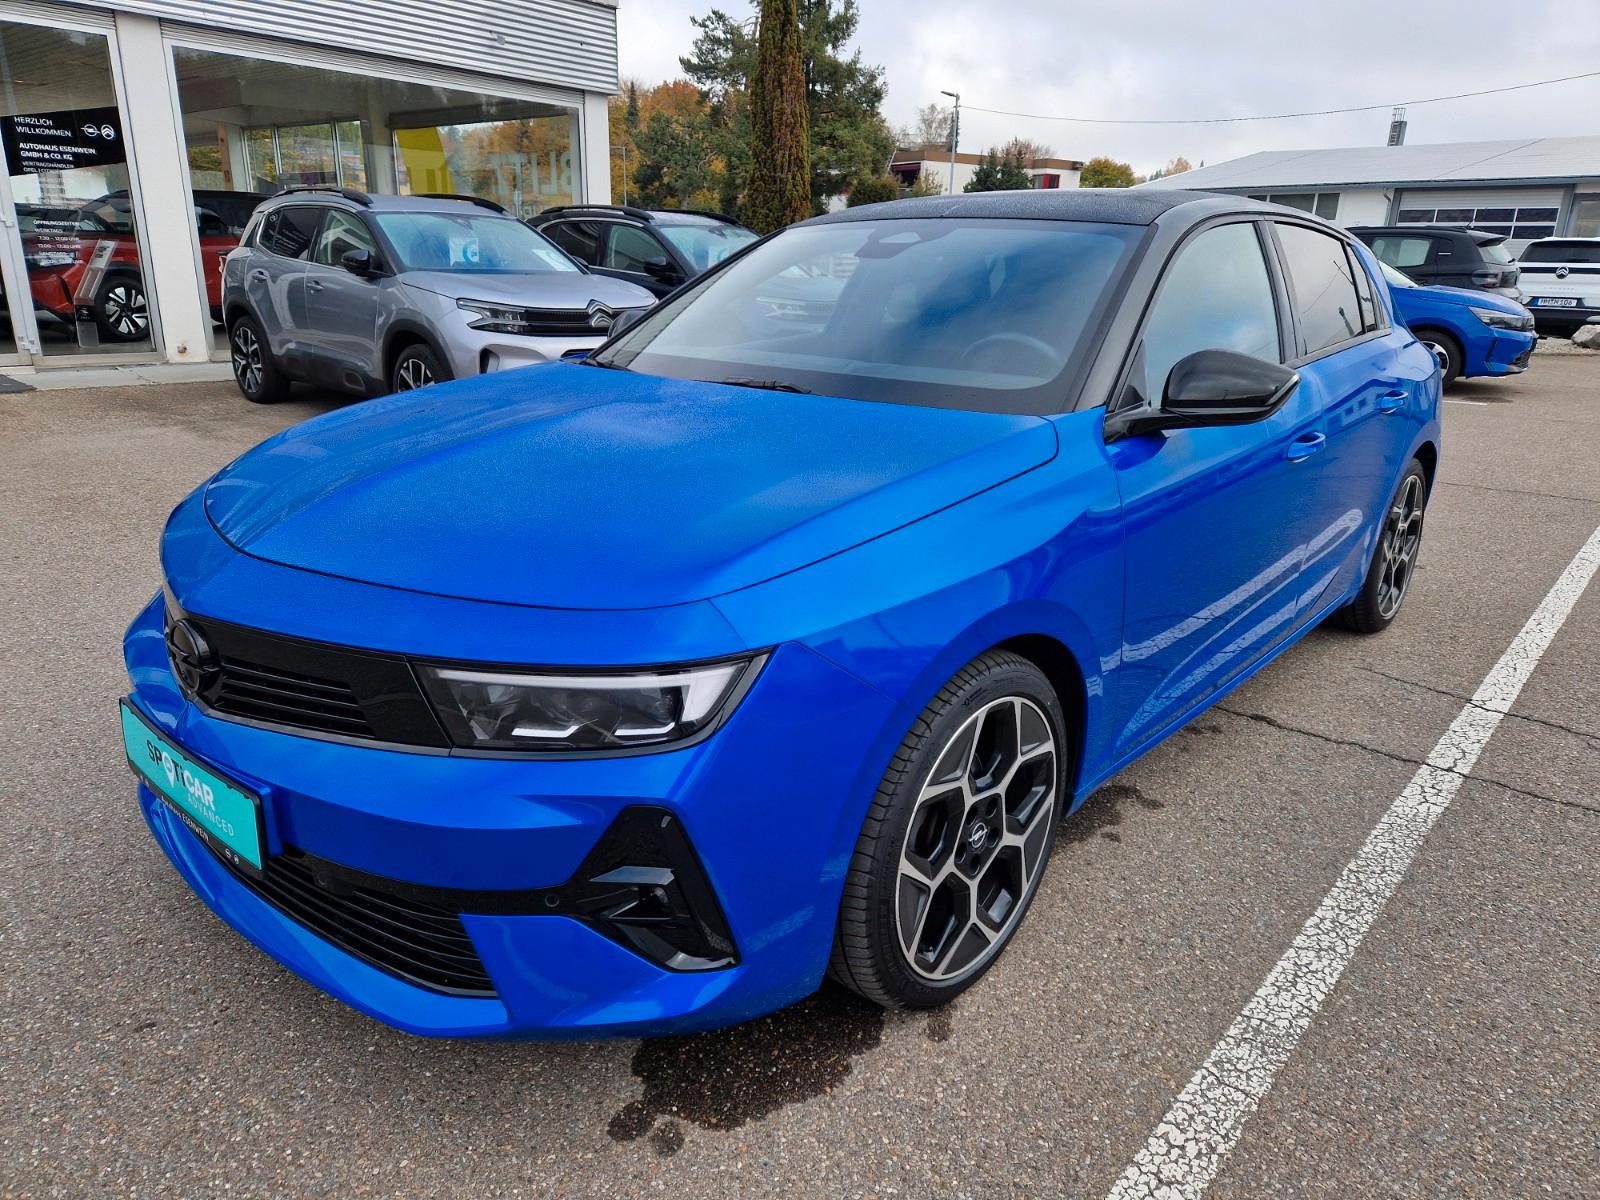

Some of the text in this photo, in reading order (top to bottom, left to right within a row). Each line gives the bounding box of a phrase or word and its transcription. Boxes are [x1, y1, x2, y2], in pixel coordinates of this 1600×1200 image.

[14, 116, 53, 126] HERZLICH
[19, 142, 96, 154] AUTOHAUS ESENWEIN
[50, 152, 62, 160] CO.
[187, 793, 235, 837] ADVANCED
